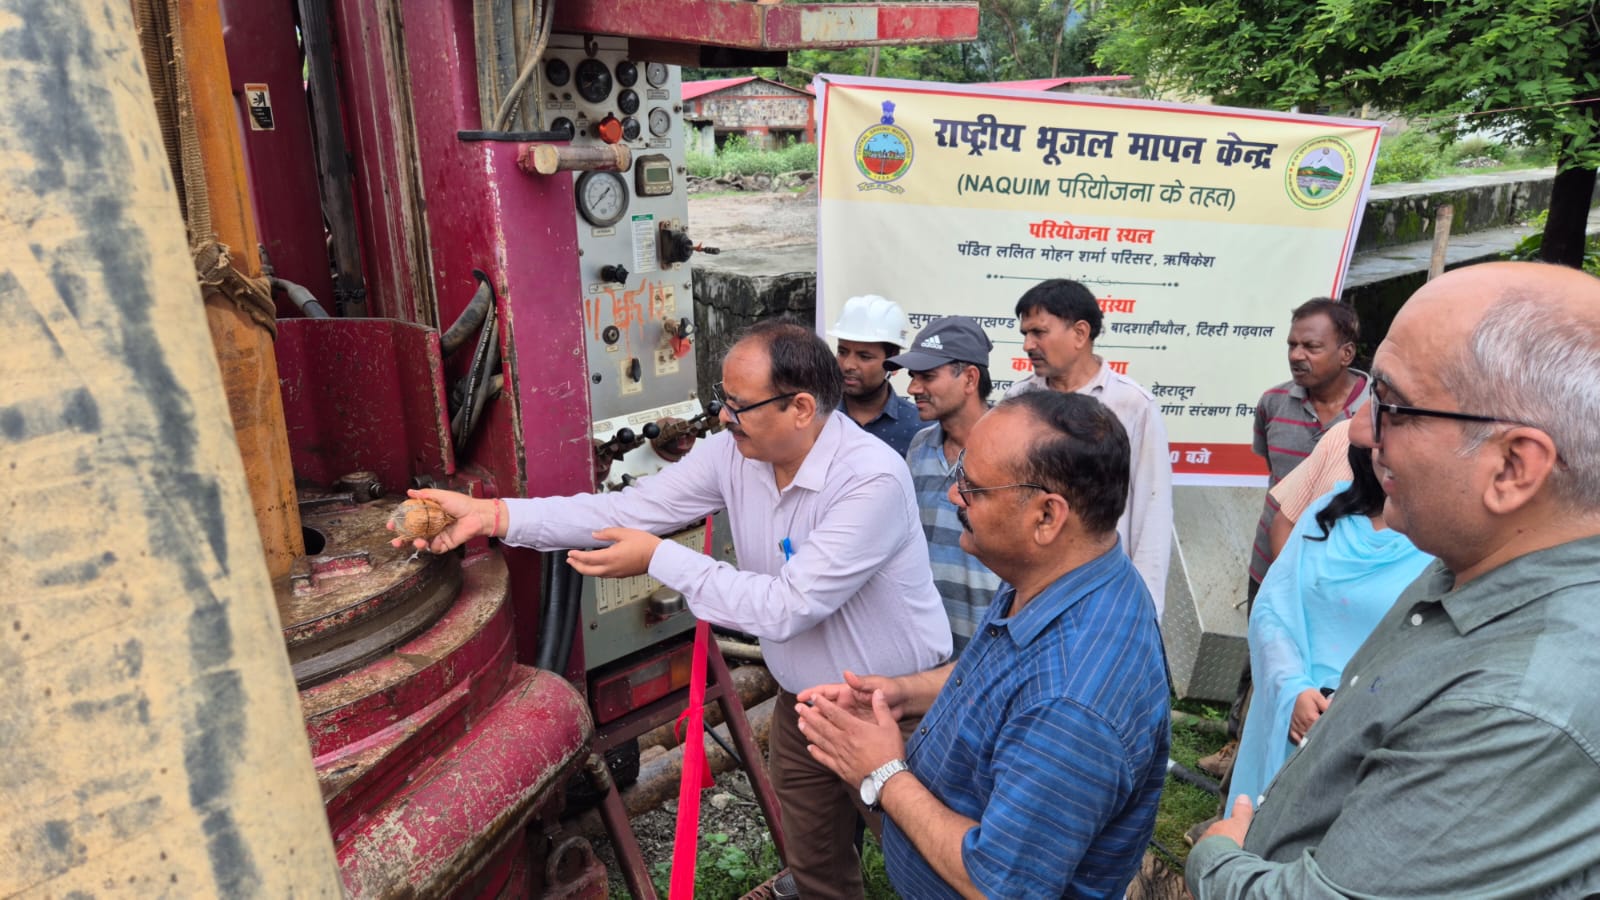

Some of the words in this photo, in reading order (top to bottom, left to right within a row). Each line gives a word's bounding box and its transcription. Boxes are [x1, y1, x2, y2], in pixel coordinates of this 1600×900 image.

[933, 114, 1026, 156] राष्ट्रीय
[1037, 126, 1118, 166] भूजल
[1128, 132, 1208, 164] मापन
[1216, 132, 1278, 170] केन्द्र
[957, 174, 1050, 197] (NAQUIM
[1058, 172, 1154, 202] परियोजना
[1159, 179, 1186, 204] के
[1189, 186, 1236, 211] तहत)
[1029, 220, 1111, 242] परियोजना
[958, 241, 991, 257] पंडित
[996, 242, 1035, 259] ललित
[1041, 245, 1073, 263] मोहन
[1079, 247, 1106, 263] शर्मा
[1111, 249, 1157, 267] परिसर,
[1163, 252, 1216, 268] ऋषिकेश
[1196, 321, 1229, 338] टिहरी
[1233, 325, 1275, 340] गढ़वाल
[1152, 381, 1196, 401] देहरादून
[1160, 402, 1185, 416] गंगा
[1189, 403, 1232, 417] संरक्षण
[1185, 448, 1213, 464] बजे
